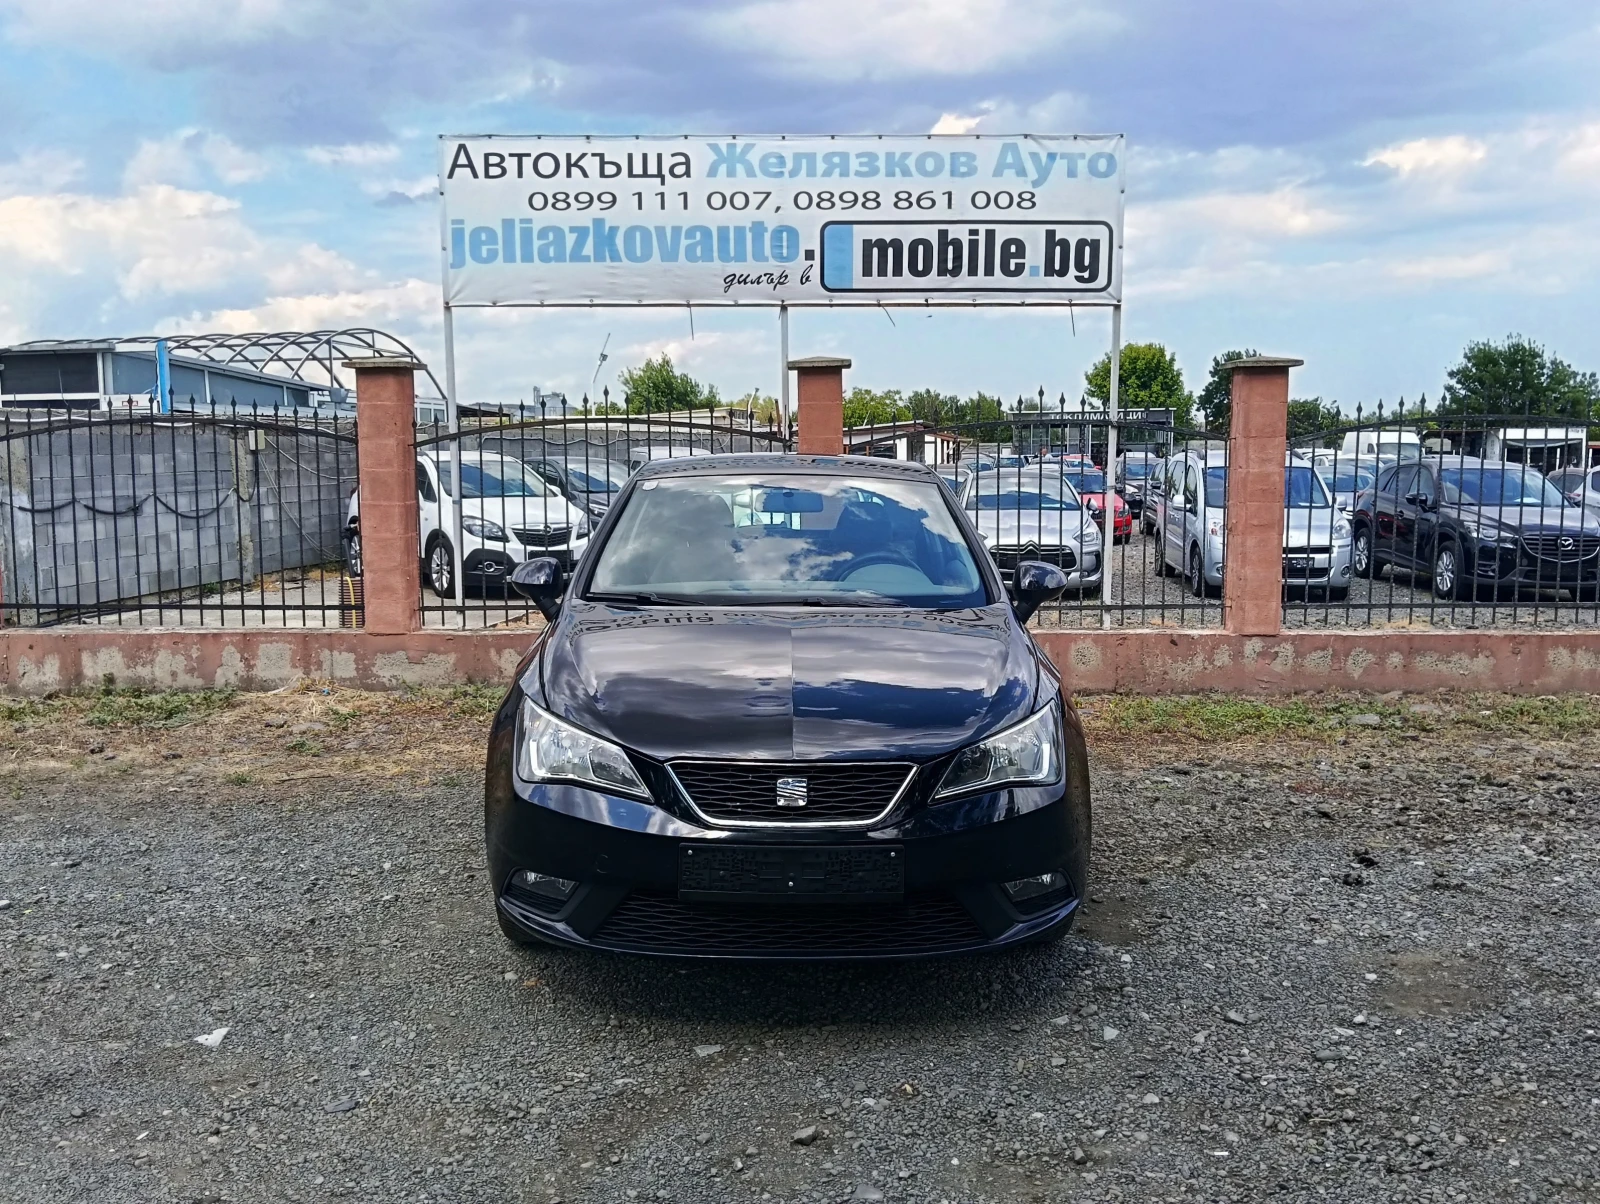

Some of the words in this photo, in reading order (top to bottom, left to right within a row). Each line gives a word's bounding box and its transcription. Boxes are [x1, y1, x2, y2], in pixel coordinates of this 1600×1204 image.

[447, 143, 691, 186] Автокъща
[706, 142, 977, 179] Желязков
[992, 142, 1117, 188] Ауто
[528, 191, 617, 211] 0899
[632, 191, 689, 211] 111
[706, 191, 781, 213] 007,
[793, 190, 881, 210] 0898
[893, 190, 952, 210] 861
[970, 190, 1036, 210] 008
[862, 228, 1101, 284] mobile.bg
[723, 270, 789, 293] дилър
